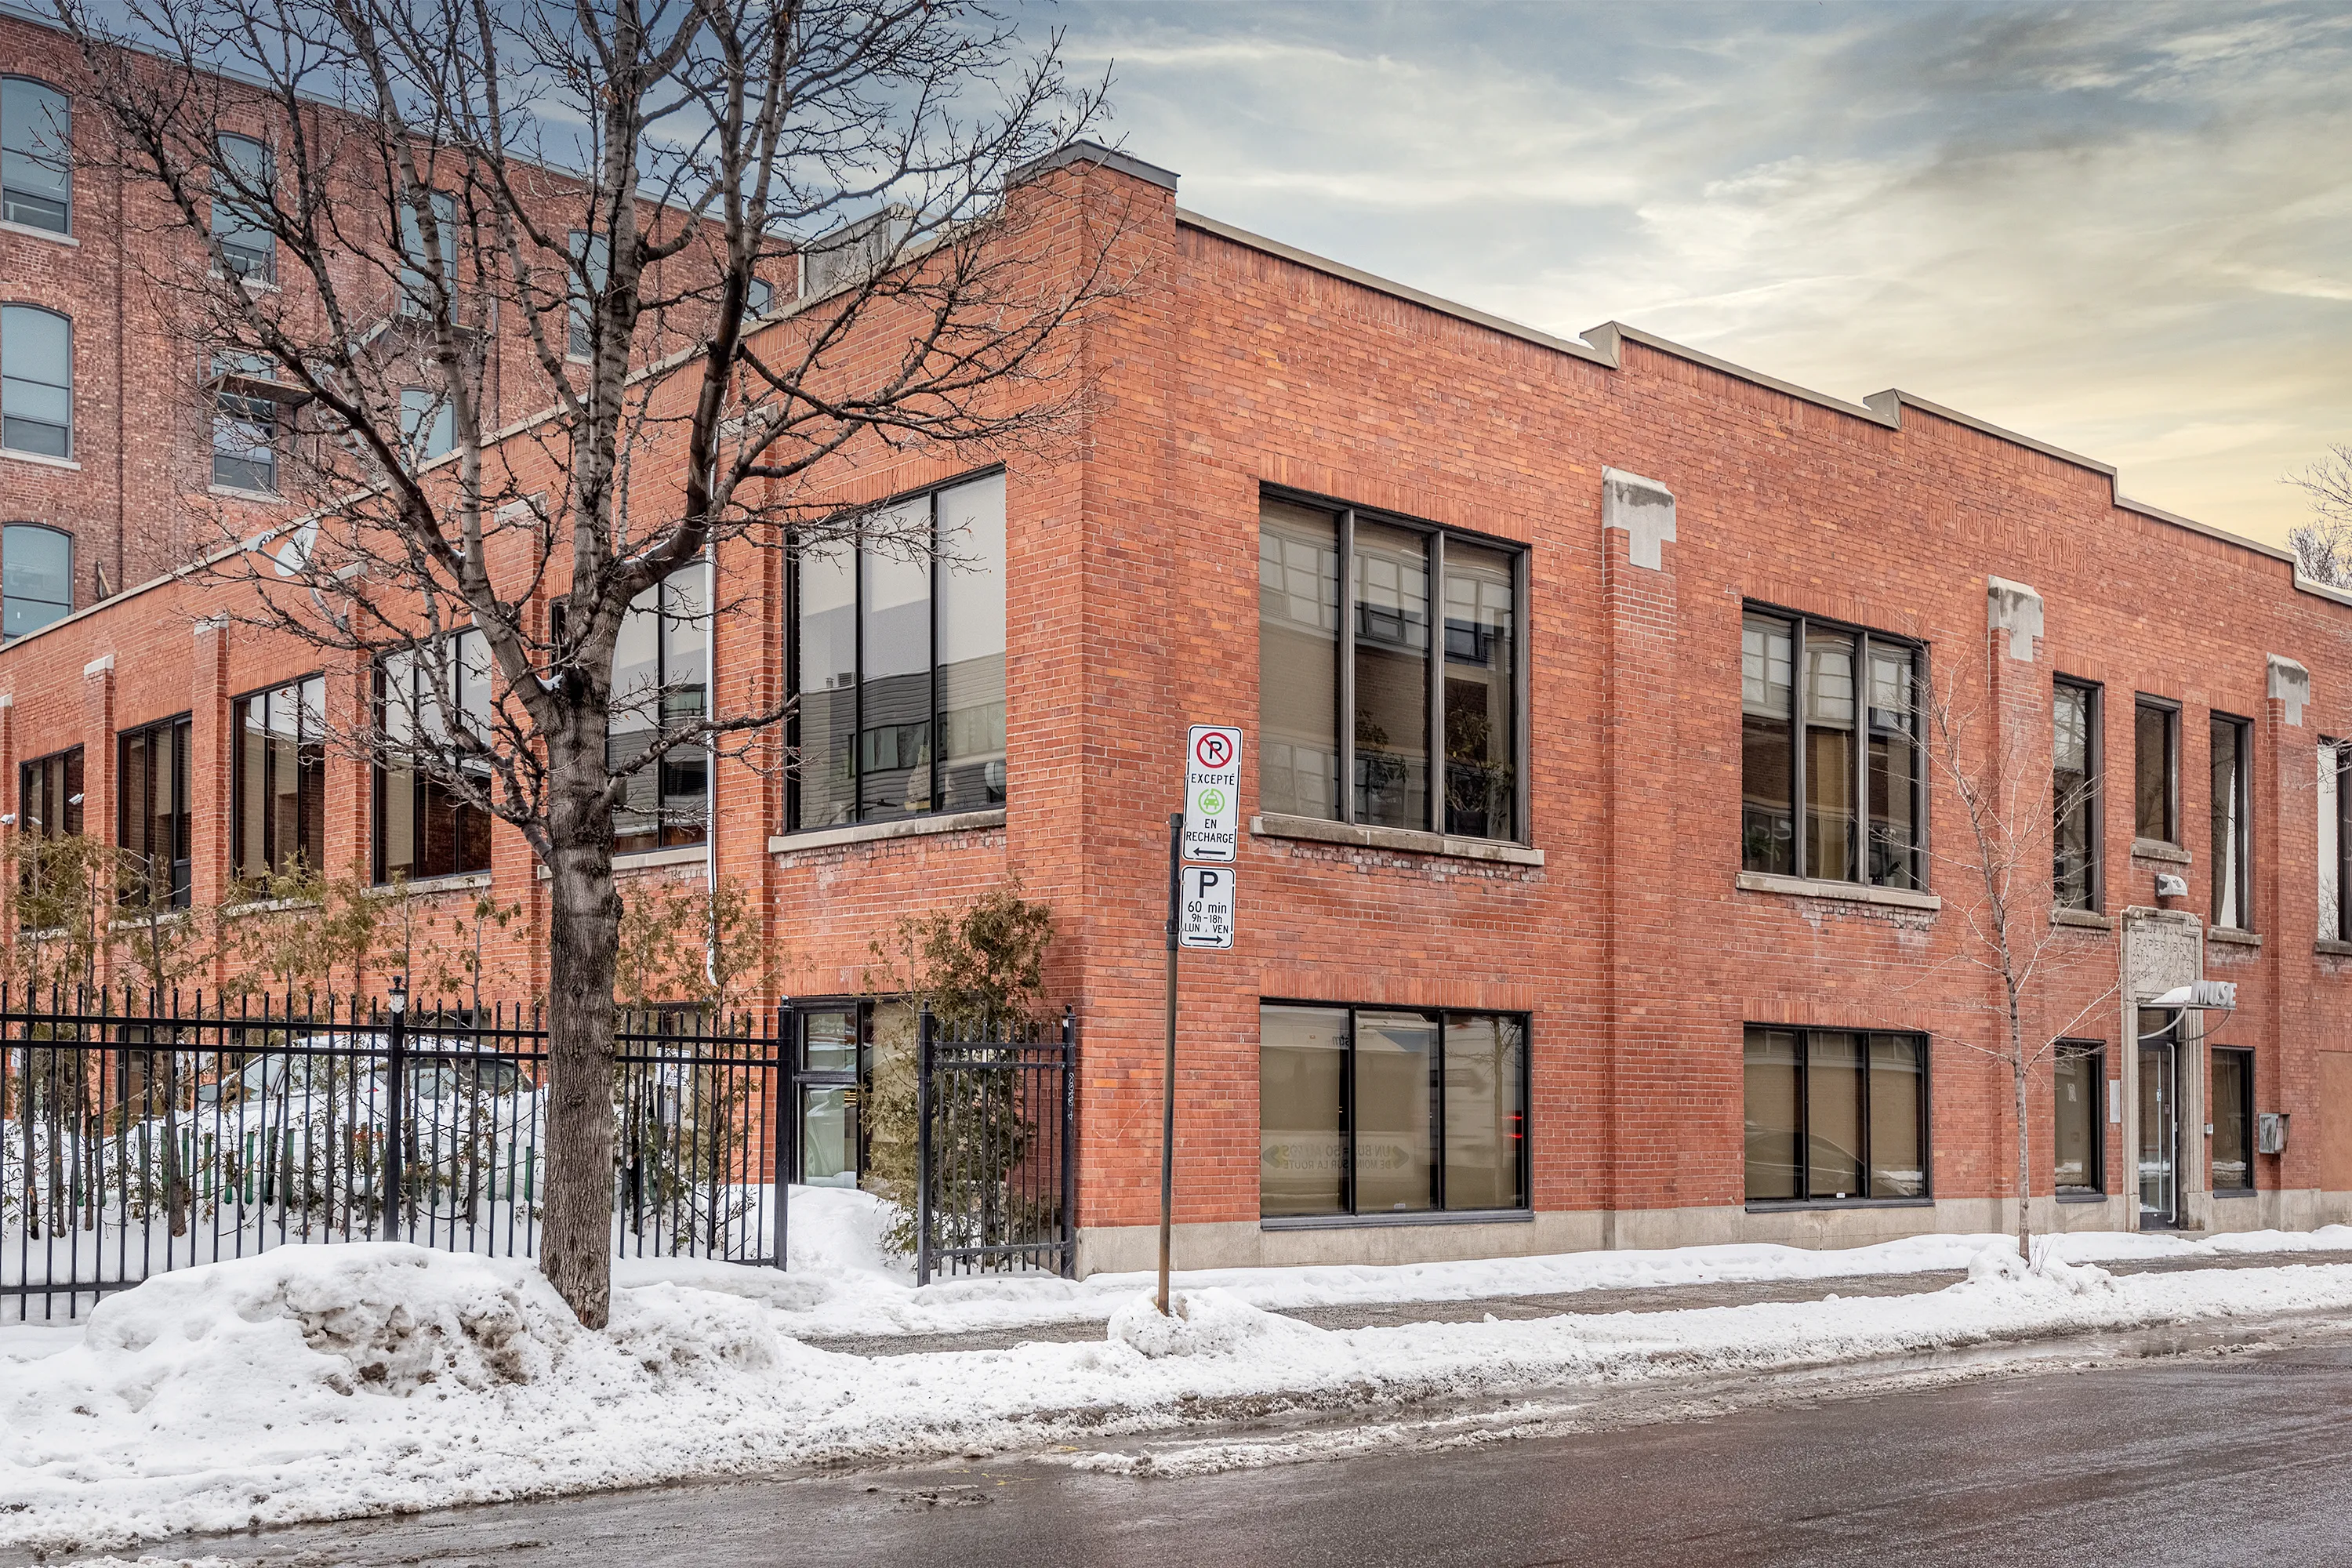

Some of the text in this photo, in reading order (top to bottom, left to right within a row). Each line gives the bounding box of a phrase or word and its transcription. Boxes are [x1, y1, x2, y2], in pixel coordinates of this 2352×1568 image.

[1191, 772, 1236, 786] EXCEPTÉ
[1204, 818, 1218, 829] EN
[1185, 830, 1235, 844] RECHARGE
[1199, 870, 1219, 898] P
[1187, 900, 1228, 914] 60 min
[1184, 922, 1201, 933] LUN
[1212, 924, 1229, 935] VEN
[2192, 980, 2237, 1006] MUSE
